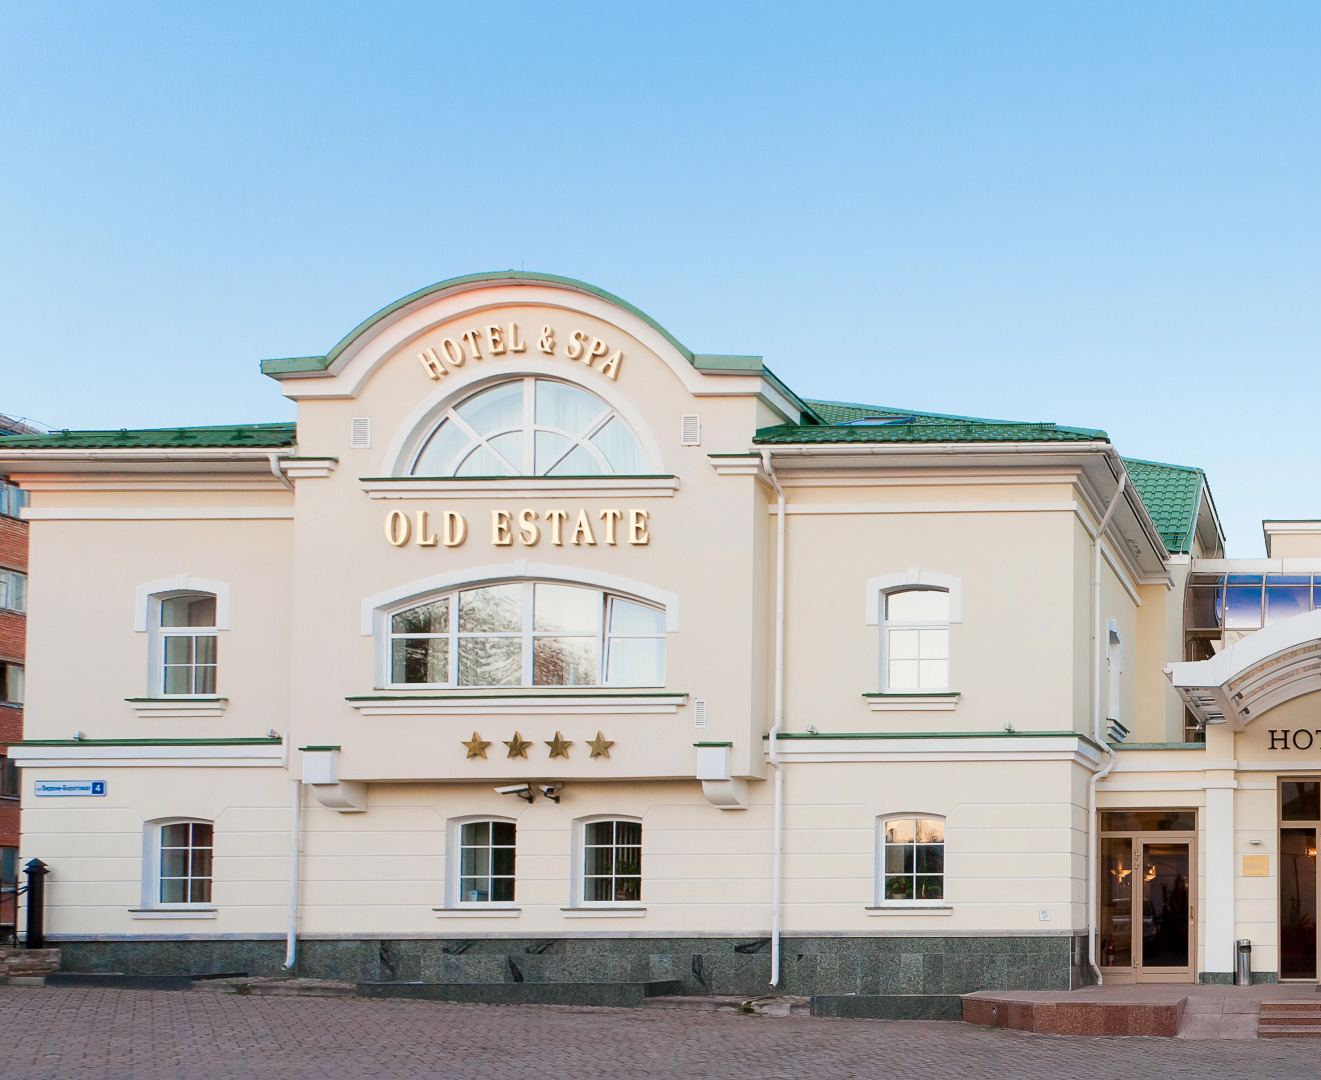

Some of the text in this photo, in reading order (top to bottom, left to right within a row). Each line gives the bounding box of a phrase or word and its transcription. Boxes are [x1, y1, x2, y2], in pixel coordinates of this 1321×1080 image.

[417, 322, 623, 381] HOTEL & SPA
[384, 507, 651, 547] OLD ESTATE
[95, 784, 101, 792] 4
